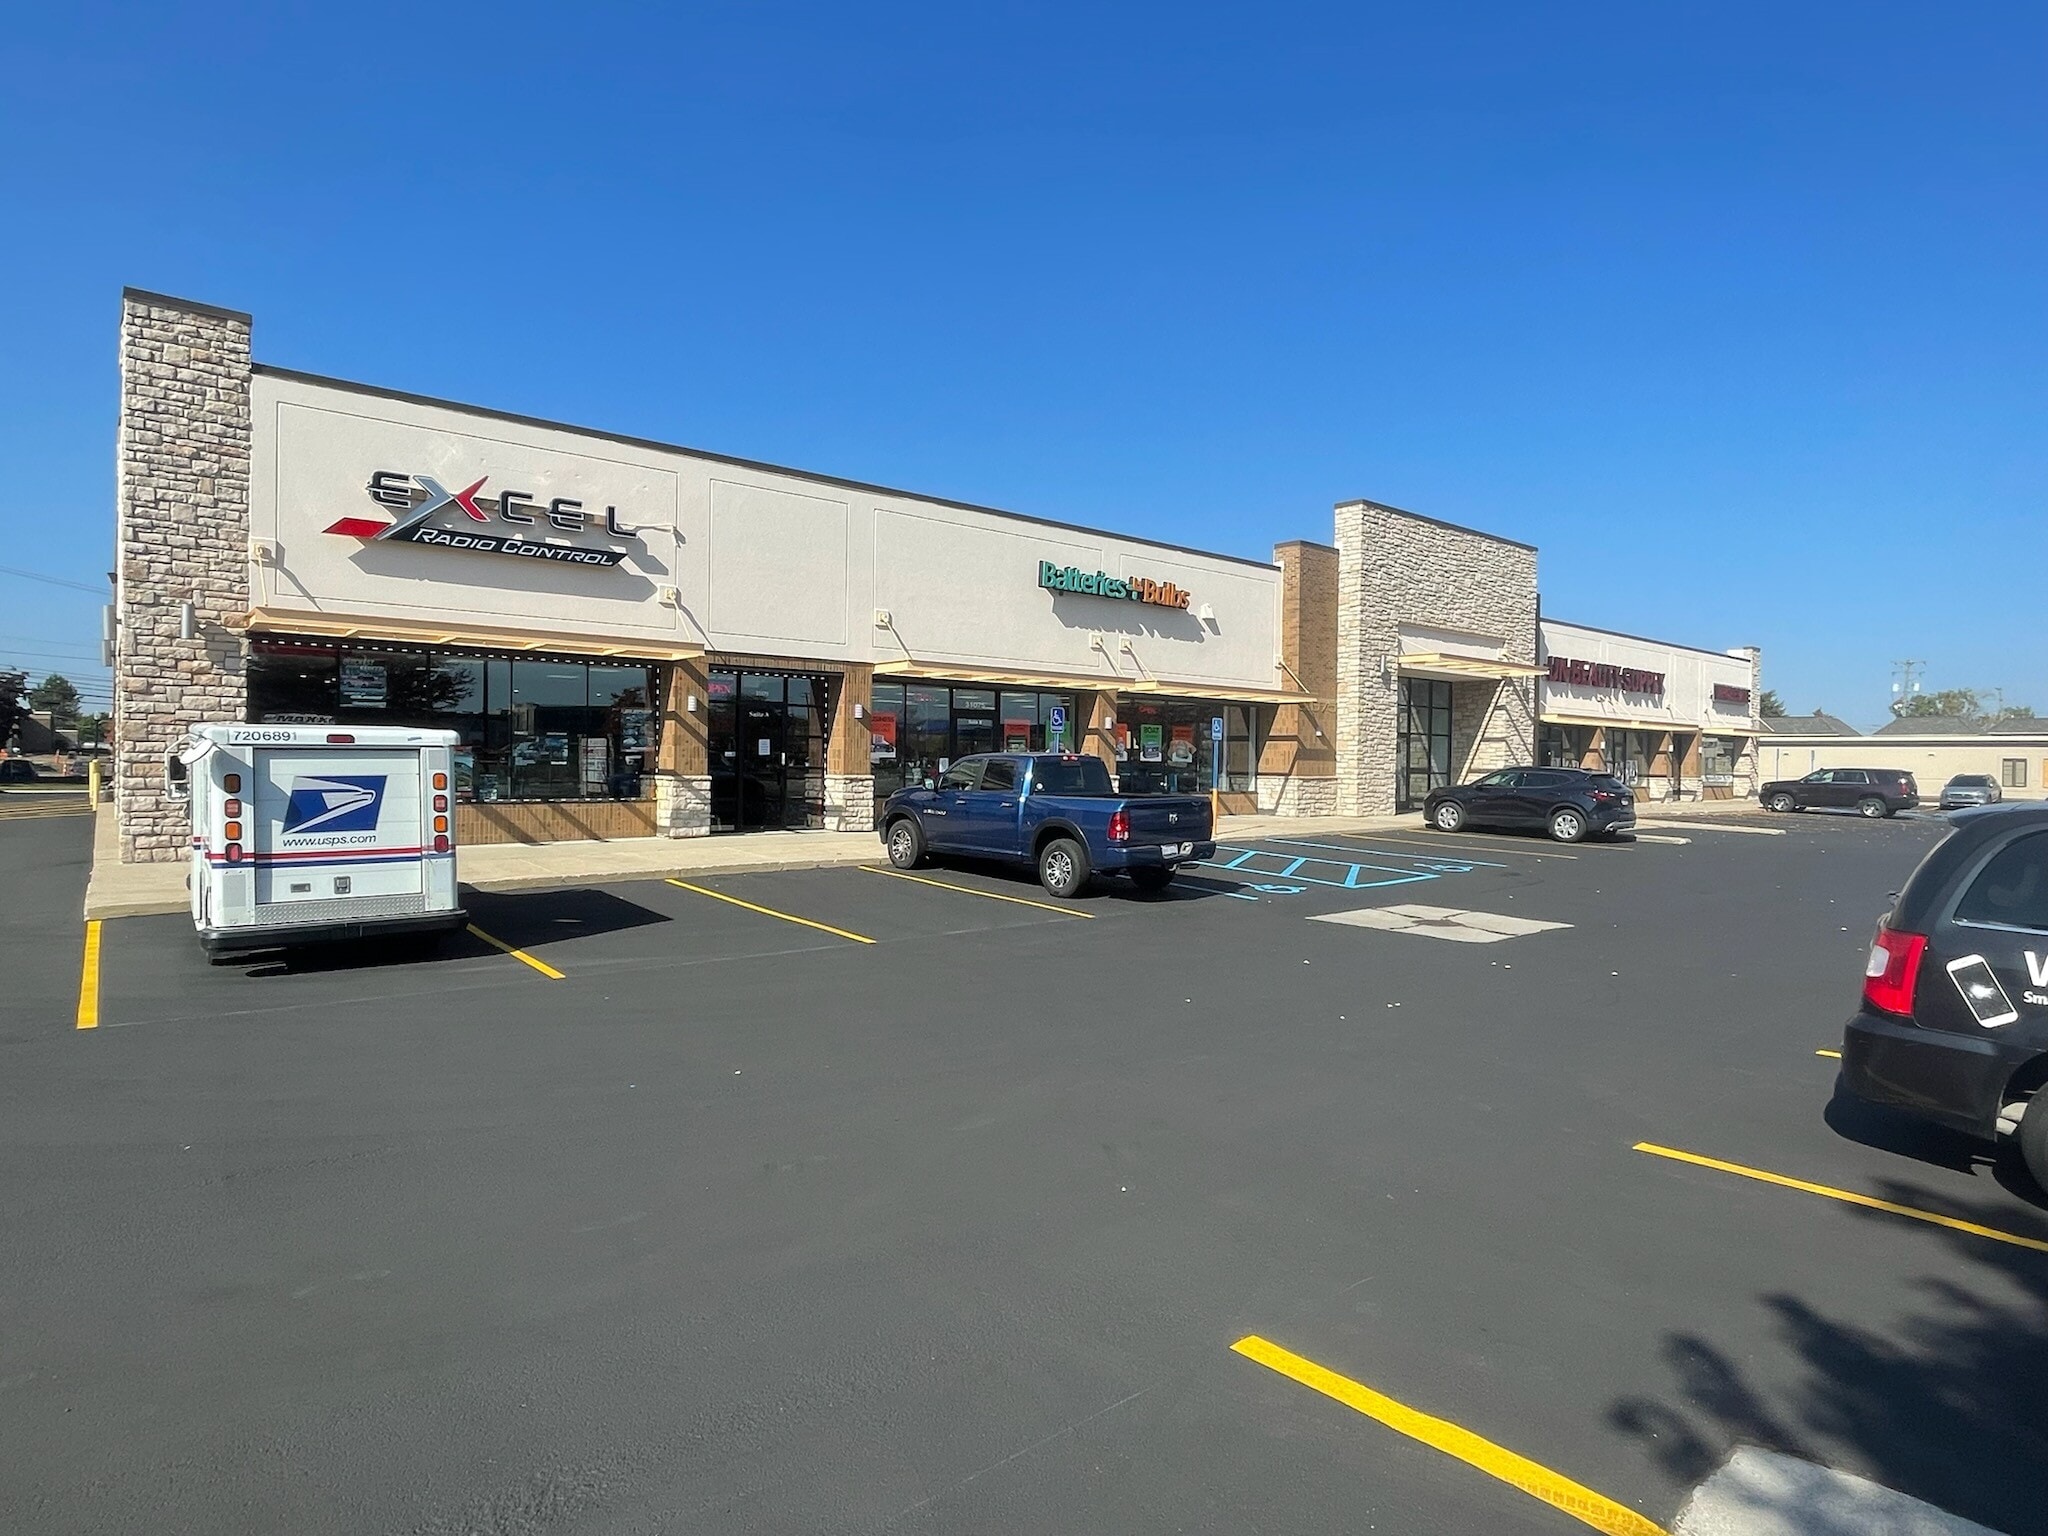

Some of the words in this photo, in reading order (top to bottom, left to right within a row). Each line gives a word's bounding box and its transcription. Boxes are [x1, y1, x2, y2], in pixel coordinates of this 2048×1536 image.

[366, 470, 637, 540] EXCEL
[1038, 560, 1128, 600] Batteries
[1142, 577, 1191, 609] Bulbs
[233, 730, 297, 742] 7206891
[282, 834, 377, 847] www.usps.com
